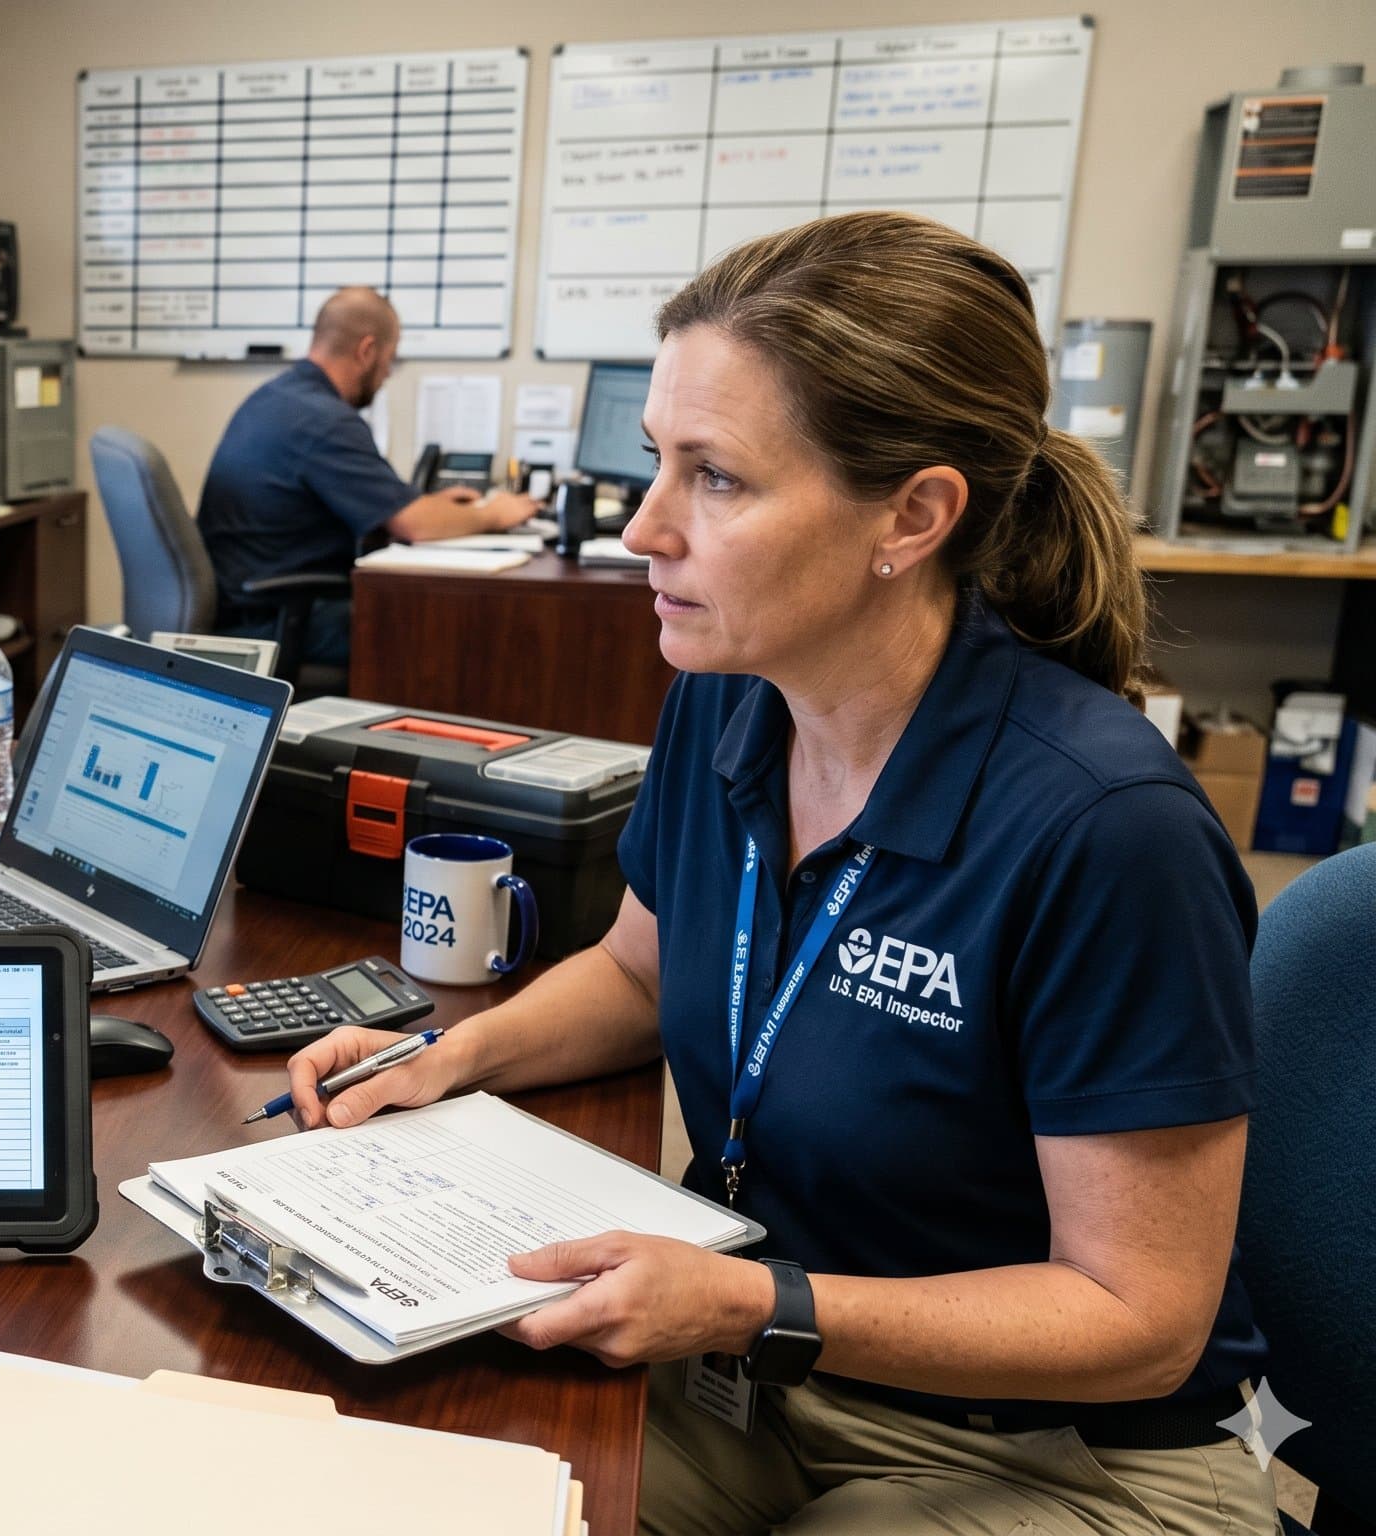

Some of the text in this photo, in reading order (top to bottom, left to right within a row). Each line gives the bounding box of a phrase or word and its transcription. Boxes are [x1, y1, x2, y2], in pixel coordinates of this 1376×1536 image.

[407, 886, 455, 922] EPA
[404, 915, 456, 948] 2024
[869, 935, 962, 1008] EPA
[829, 974, 964, 1033] U.S. EPA Inspector
[370, 1277, 408, 1300] EPA
